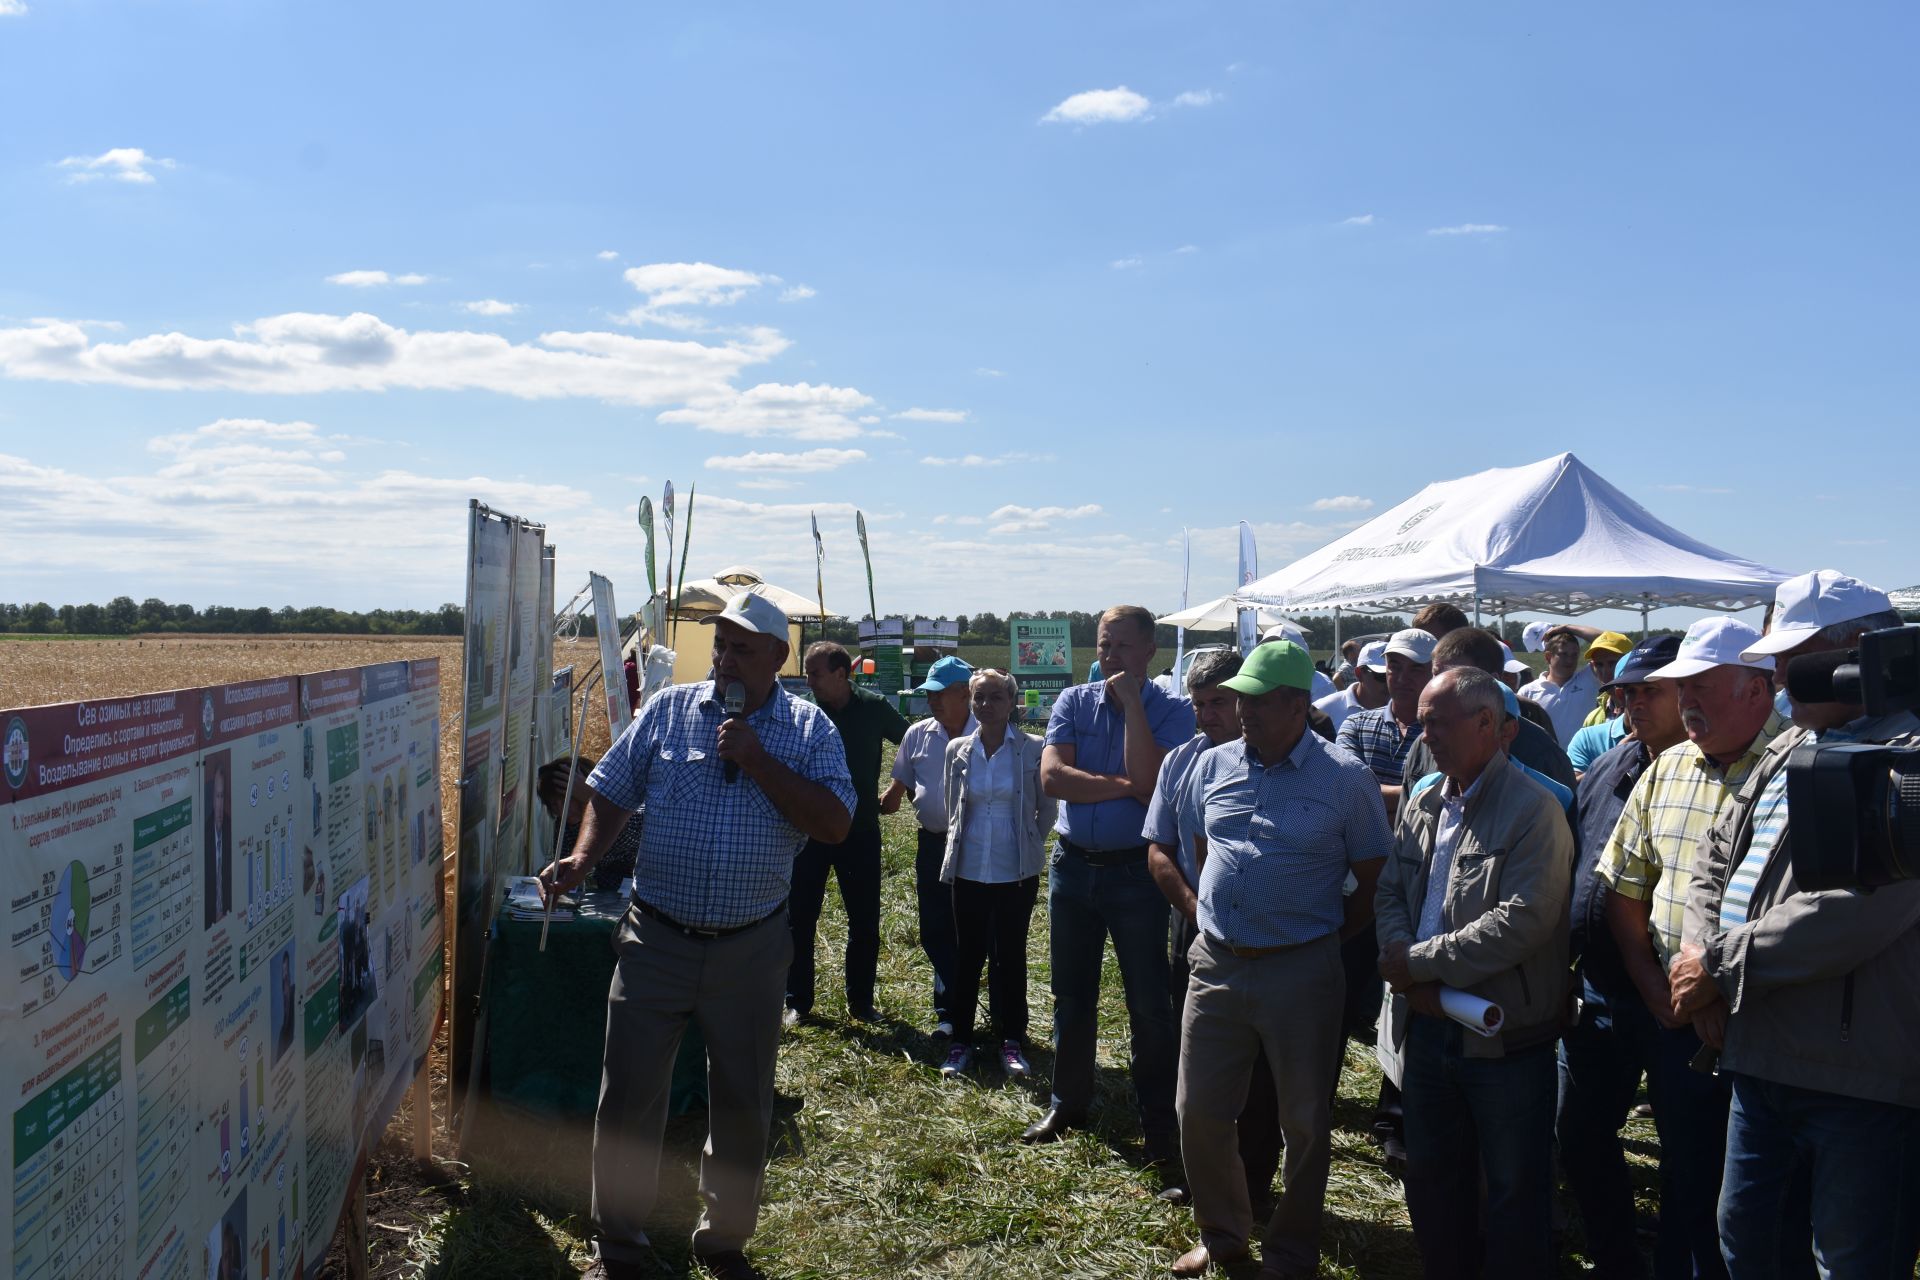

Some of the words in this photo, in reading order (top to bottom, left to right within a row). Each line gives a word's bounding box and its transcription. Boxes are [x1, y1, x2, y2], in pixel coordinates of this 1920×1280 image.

[78, 703, 96, 726] Сев
[99, 703, 130, 722] озимых
[132, 701, 141, 717] не
[143, 699, 150, 715] за
[151, 691, 175, 717] горами!
[64, 733, 111, 756] Определись
[113, 730, 118, 744] с
[119, 726, 144, 745] сортами
[145, 724, 149, 736] и
[40, 758, 100, 784] Возделывание
[103, 751, 128, 769] озимых
[130, 748, 137, 762] не
[139, 744, 157, 762] терпит
[12, 816, 19, 830] 1.
[51, 807, 61, 819] вес
